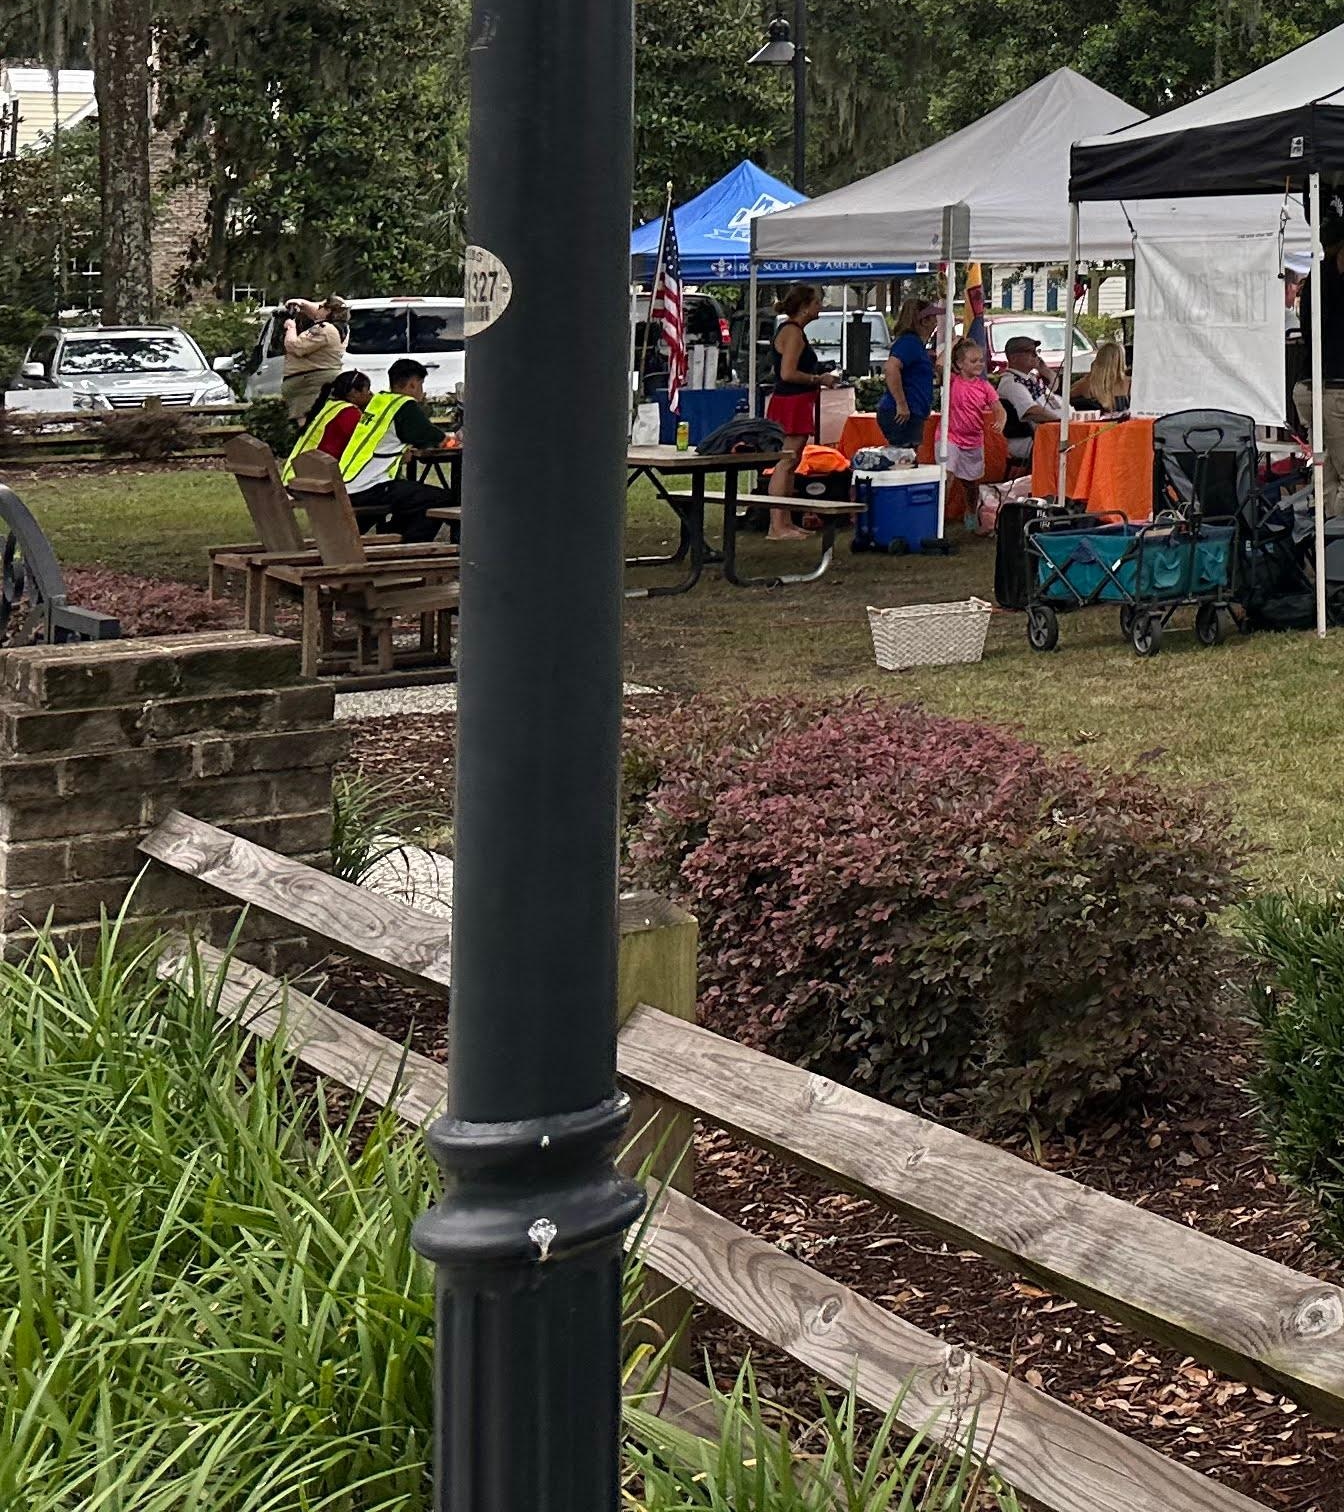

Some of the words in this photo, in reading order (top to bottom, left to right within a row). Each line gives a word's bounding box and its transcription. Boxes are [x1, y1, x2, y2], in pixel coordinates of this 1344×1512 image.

[763, 261, 806, 272] SCOUTS
[808, 261, 822, 270] OF
[825, 260, 873, 270] AMERICA
